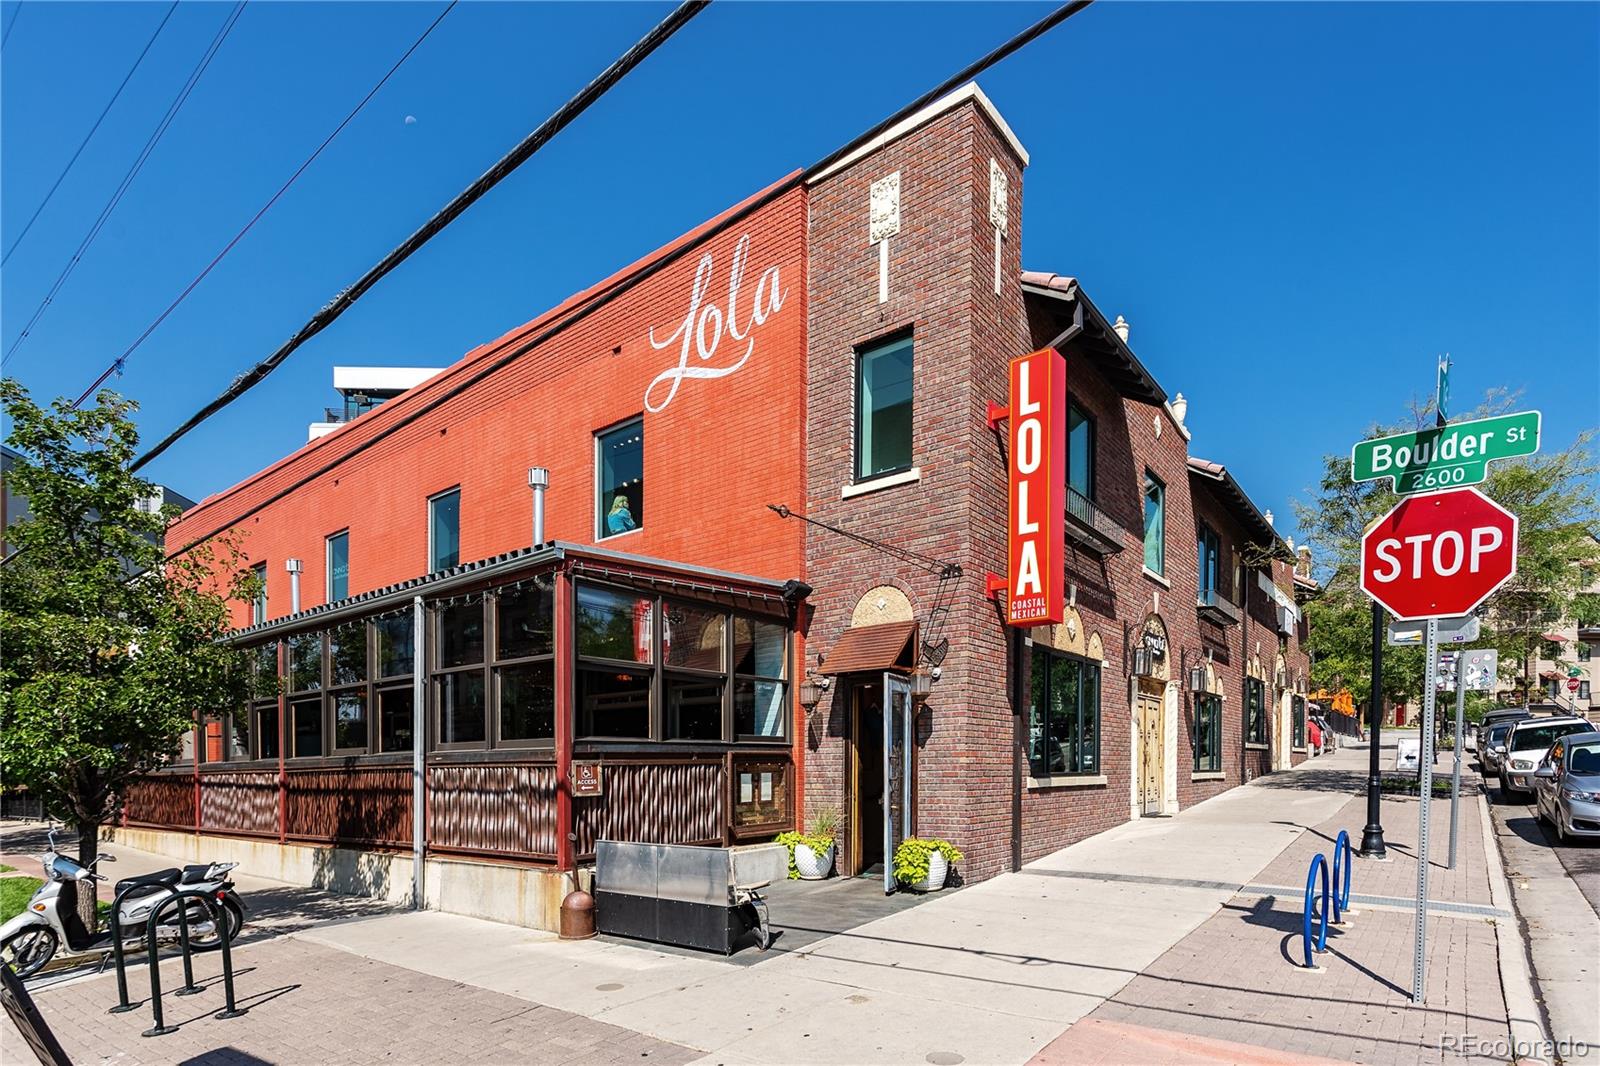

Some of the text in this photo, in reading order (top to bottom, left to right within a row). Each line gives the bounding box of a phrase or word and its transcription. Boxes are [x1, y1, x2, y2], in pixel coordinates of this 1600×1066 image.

[644, 233, 788, 413] Lola
[1371, 426, 1527, 473] Boulder St
[1016, 361, 1042, 596] LOLA
[1412, 467, 1465, 489] 2600
[1372, 526, 1503, 583] STOP
[1011, 597, 1046, 610] COASTAL
[1011, 607, 1046, 620] MEXICAN
